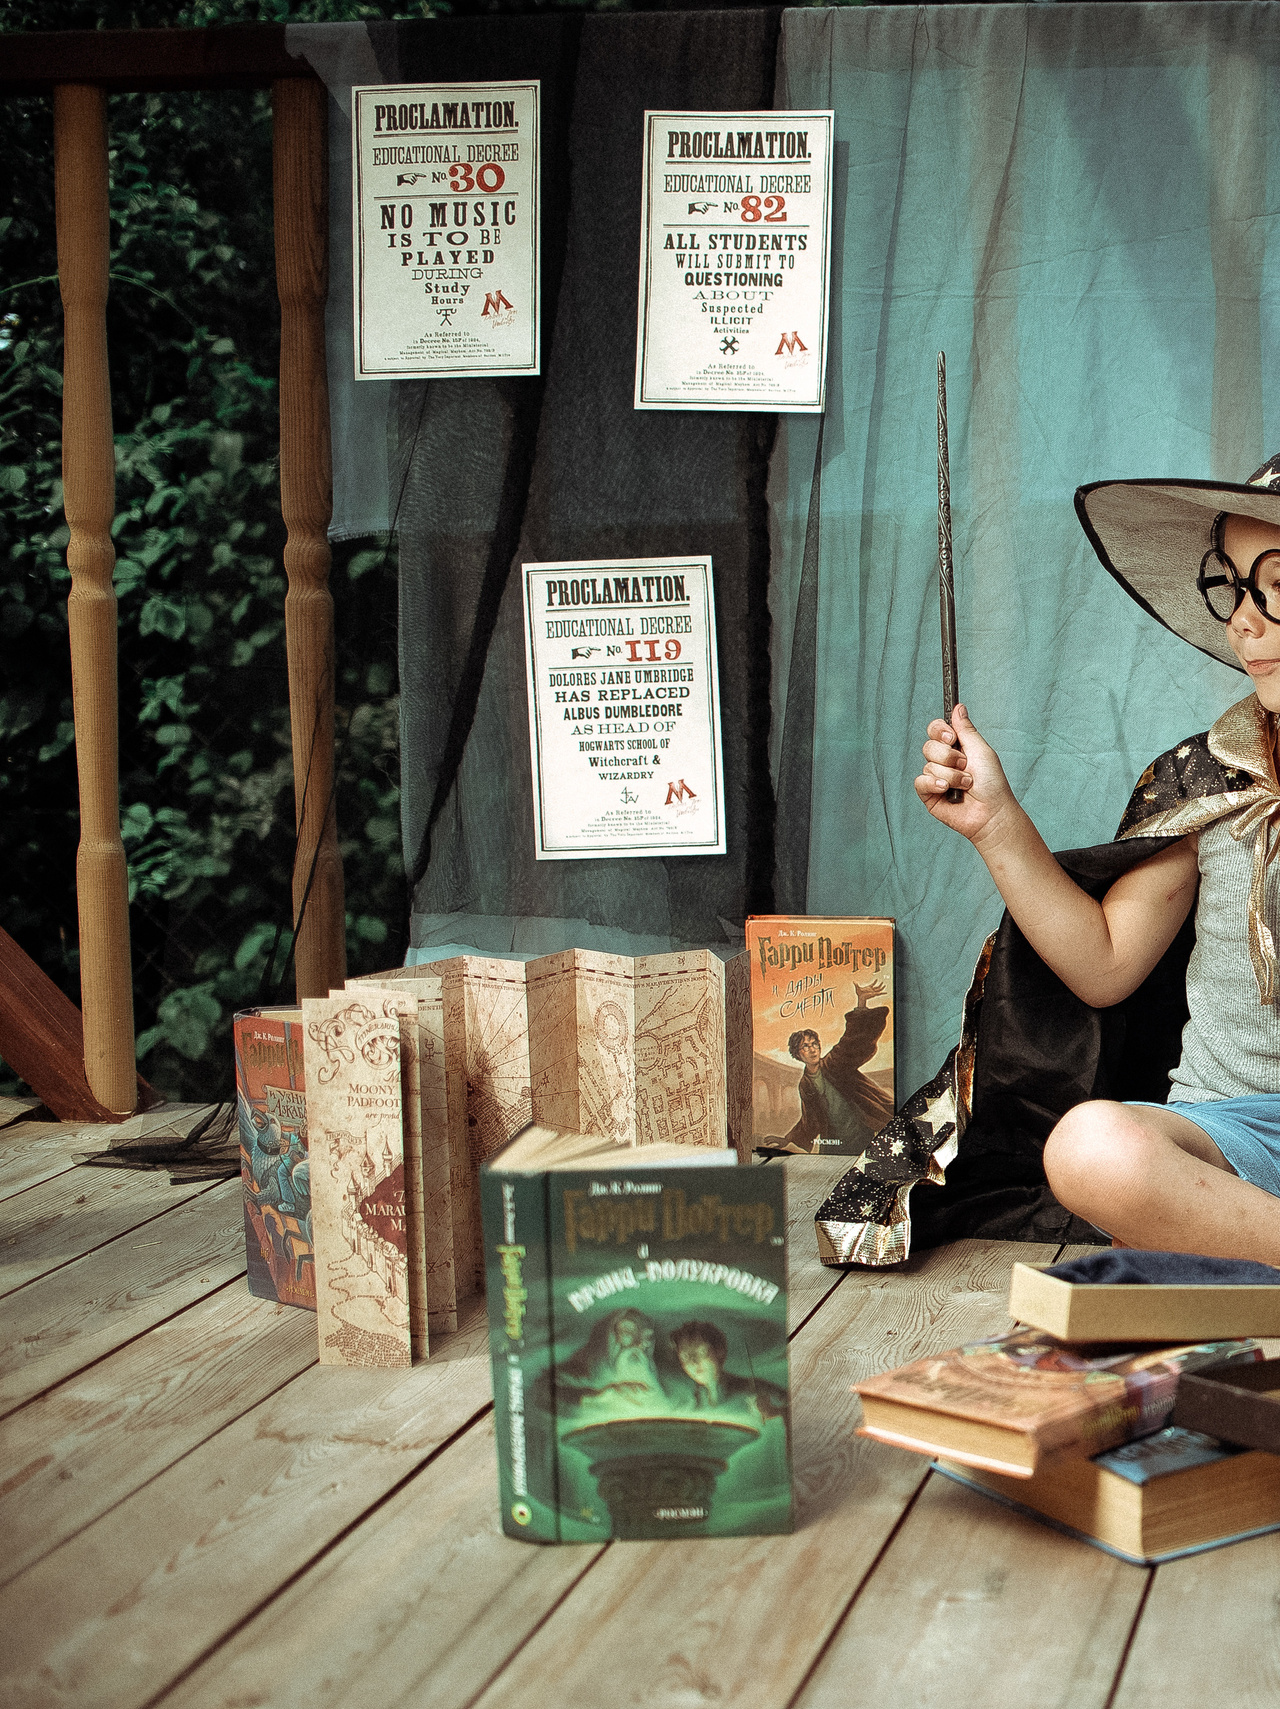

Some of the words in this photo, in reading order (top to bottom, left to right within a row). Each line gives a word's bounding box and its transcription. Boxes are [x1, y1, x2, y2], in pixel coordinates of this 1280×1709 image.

[374, 101, 519, 131] PROCLAMATION.
[668, 130, 812, 158] PROCLAMATION.
[373, 145, 460, 166] EDUCATIONAL
[466, 143, 518, 162] DECREE
[448, 162, 505, 192] 30
[664, 174, 753, 194] EDUCATIONAL
[760, 174, 811, 194] DECREE
[380, 203, 413, 229] NO
[430, 200, 516, 228] MUSIC
[740, 196, 787, 222] 82
[388, 233, 412, 248] IS
[423, 232, 468, 246] TO
[480, 229, 501, 244] BE
[664, 234, 700, 250] ALL
[709, 234, 808, 250] STUDENTS
[402, 250, 494, 266] PLAYED
[676, 254, 710, 268] WILL
[717, 254, 772, 269] SUBMIT
[779, 254, 794, 269] TO
[412, 268, 483, 280] DURING
[684, 272, 782, 287] QUESTIONING
[424, 282, 470, 296] Study
[692, 290, 773, 301] ABOUT
[431, 296, 464, 304] Hours
[702, 302, 763, 316] Suspected
[710, 316, 753, 325] ILLICIT
[714, 326, 750, 334] Activities
[546, 575, 690, 606] PROCLAMATION.
[546, 618, 634, 639] EDUCATIONAL
[641, 616, 692, 634] DECREE
[625, 638, 682, 662] 119
[550, 672, 596, 688] DOLORES
[600, 670, 631, 685] JANE
[634, 668, 694, 684] UMBRIDGE
[555, 690, 590, 703] HAS
[598, 686, 690, 701] REPLACED
[564, 706, 600, 720] ALBUS
[605, 704, 682, 718] DUMBLEDORE
[571, 725, 594, 736] AS
[600, 722, 650, 734] HEAD
[654, 721, 676, 732] OF
[579, 740, 624, 752] HOGWARTS
[628, 739, 658, 750] SCHOOL
[661, 738, 670, 749] OF
[589, 756, 648, 767] Witchcraft
[652, 756, 661, 765] &
[599, 771, 654, 780] WIZARDRY
[758, 936, 814, 983] Гарри
[818, 937, 886, 973] Поттер
[773, 985, 778, 997] и
[349, 1083, 395, 1095] MOONY
[348, 1096, 400, 1108] PADFOOT
